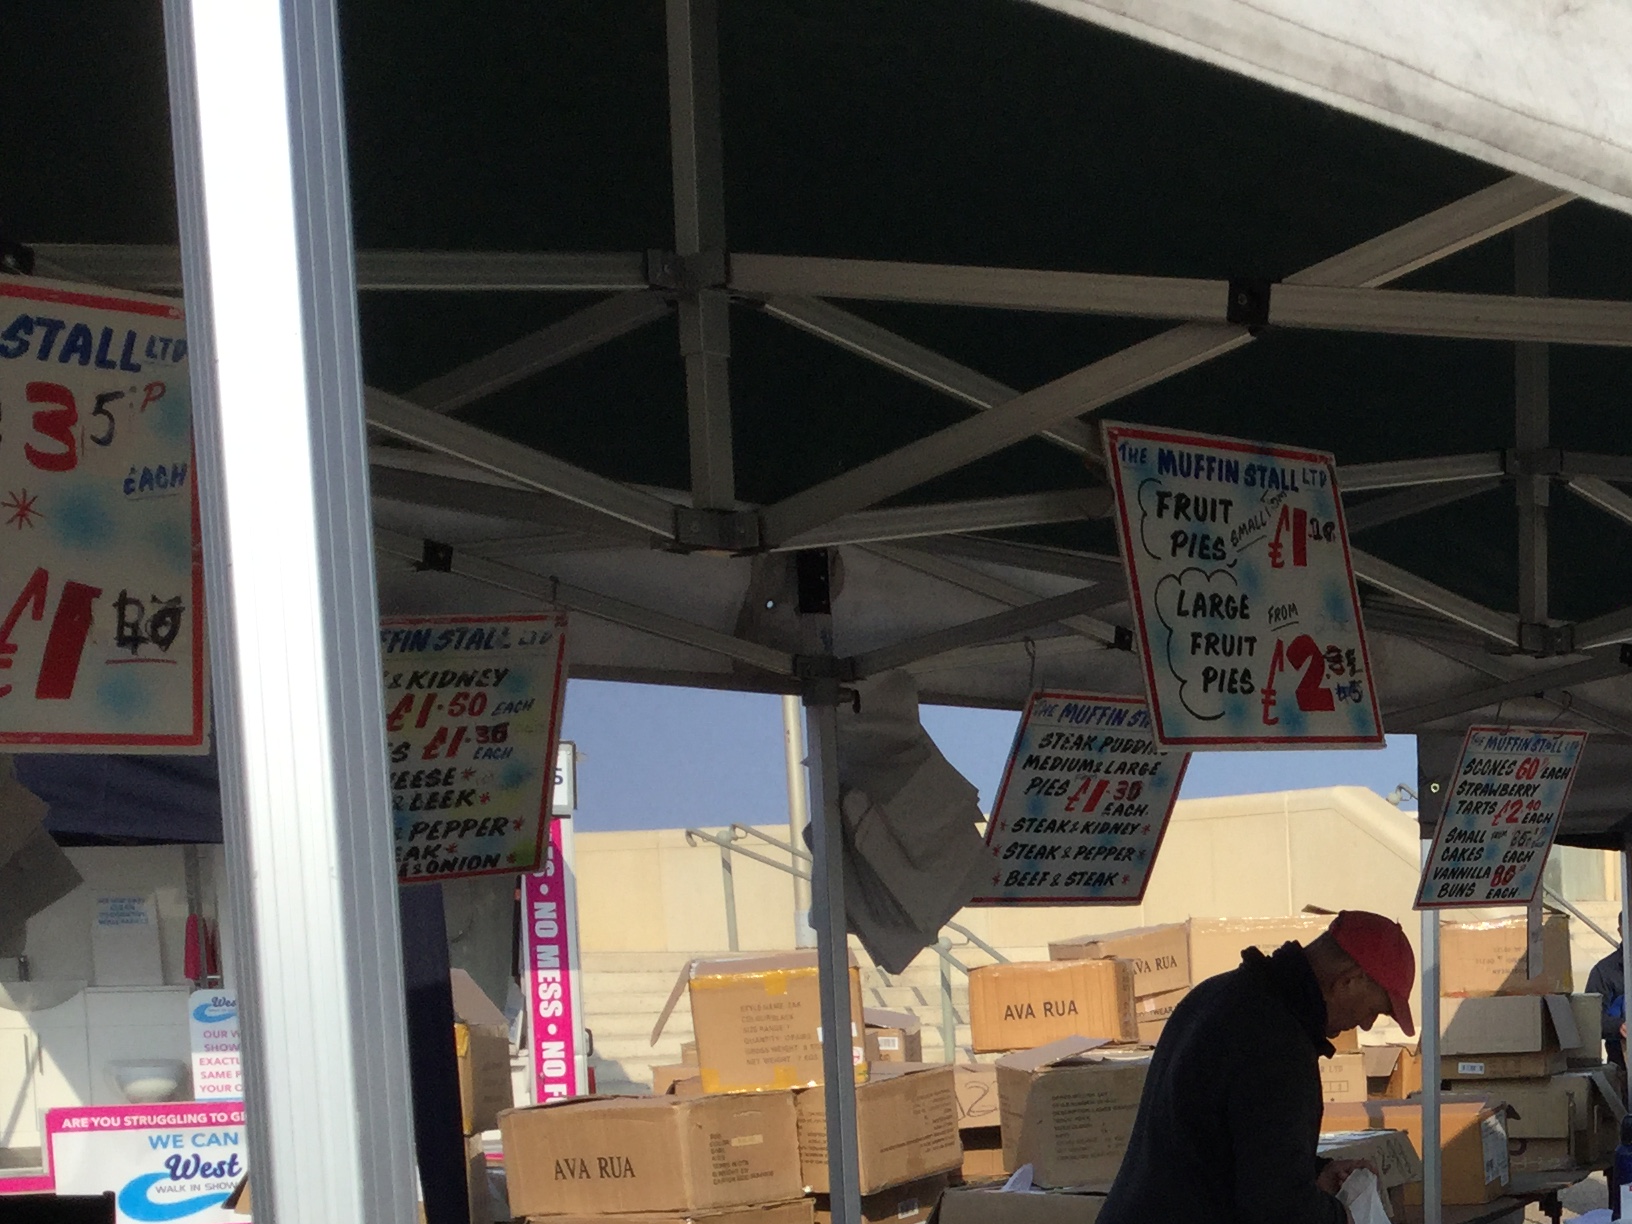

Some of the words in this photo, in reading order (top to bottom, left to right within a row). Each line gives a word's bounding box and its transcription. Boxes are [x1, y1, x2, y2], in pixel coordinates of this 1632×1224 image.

[0, 314, 141, 373] STALL
[1118, 441, 1147, 466] THE
[1157, 447, 1239, 485] MUFFIN
[1244, 467, 1299, 492] STALL
[1302, 468, 1327, 488] LTD
[123, 463, 188, 495] EACH
[1155, 489, 1233, 524] FRUIT
[1169, 529, 1227, 561] PIES
[1177, 589, 1250, 620] LARGE
[1267, 602, 1298, 625] FROM
[433, 626, 512, 651] STALL
[1190, 632, 1257, 657] FRUIT
[406, 668, 509, 690] KIDNEY
[1201, 665, 1256, 696] PIES
[491, 698, 535, 717] EACH
[1057, 702, 1130, 726] MUFFIN
[1038, 732, 1098, 751] STEAK
[1485, 735, 1530, 751] MUFFIN
[473, 746, 514, 760] EACH
[1022, 754, 1095, 775] MEDIUM
[1103, 760, 1162, 777] LARGE
[1463, 757, 1517, 776] SCONES
[1540, 766, 1571, 780] EACH
[1024, 776, 1070, 797] PIES
[1456, 780, 1541, 797] STRAWBERRY
[409, 789, 476, 812] LEEK
[1455, 800, 1498, 815] TARTS
[1521, 812, 1554, 825] EACH
[408, 816, 510, 842] PEPPER
[1011, 817, 1071, 834] STEAK
[1080, 821, 1141, 836] KIDNEY
[1445, 827, 1488, 843] SMALL
[1003, 842, 1061, 860] STEAK
[1073, 846, 1136, 862] PEPPER
[1440, 847, 1484, 862] CAKES
[1502, 850, 1535, 864] EACH
[425, 853, 501, 874] ONION
[1432, 865, 1491, 880] VANNILLA
[1004, 870, 1050, 887] BEEF
[1050, 873, 1061, 886] &
[1064, 871, 1119, 887] STEAK
[1437, 882, 1477, 899] BUNS
[534, 901, 557, 938] NO
[1156, 955, 1178, 971] RUA
[536, 946, 563, 1018] MESS
[1004, 1003, 1036, 1021] AVA
[1043, 1000, 1079, 1018] RUA
[203, 1030, 228, 1039] OUR
[200, 1070, 233, 1079] SAME
[200, 1084, 232, 1093] YOUR
[62, 1117, 89, 1128] ARE
[91, 1116, 121, 1127] YOU
[123, 1113, 207, 1126] STRUGGLING
[209, 1112, 228, 1123] TO
[148, 1134, 184, 1150] WE
[191, 1132, 239, 1147] CAN
[164, 1153, 242, 1181] West
[554, 1158, 591, 1180] AVA
[596, 1156, 636, 1179] RUA
[155, 1184, 186, 1194] WALK
[190, 1183, 201, 1192] IN
